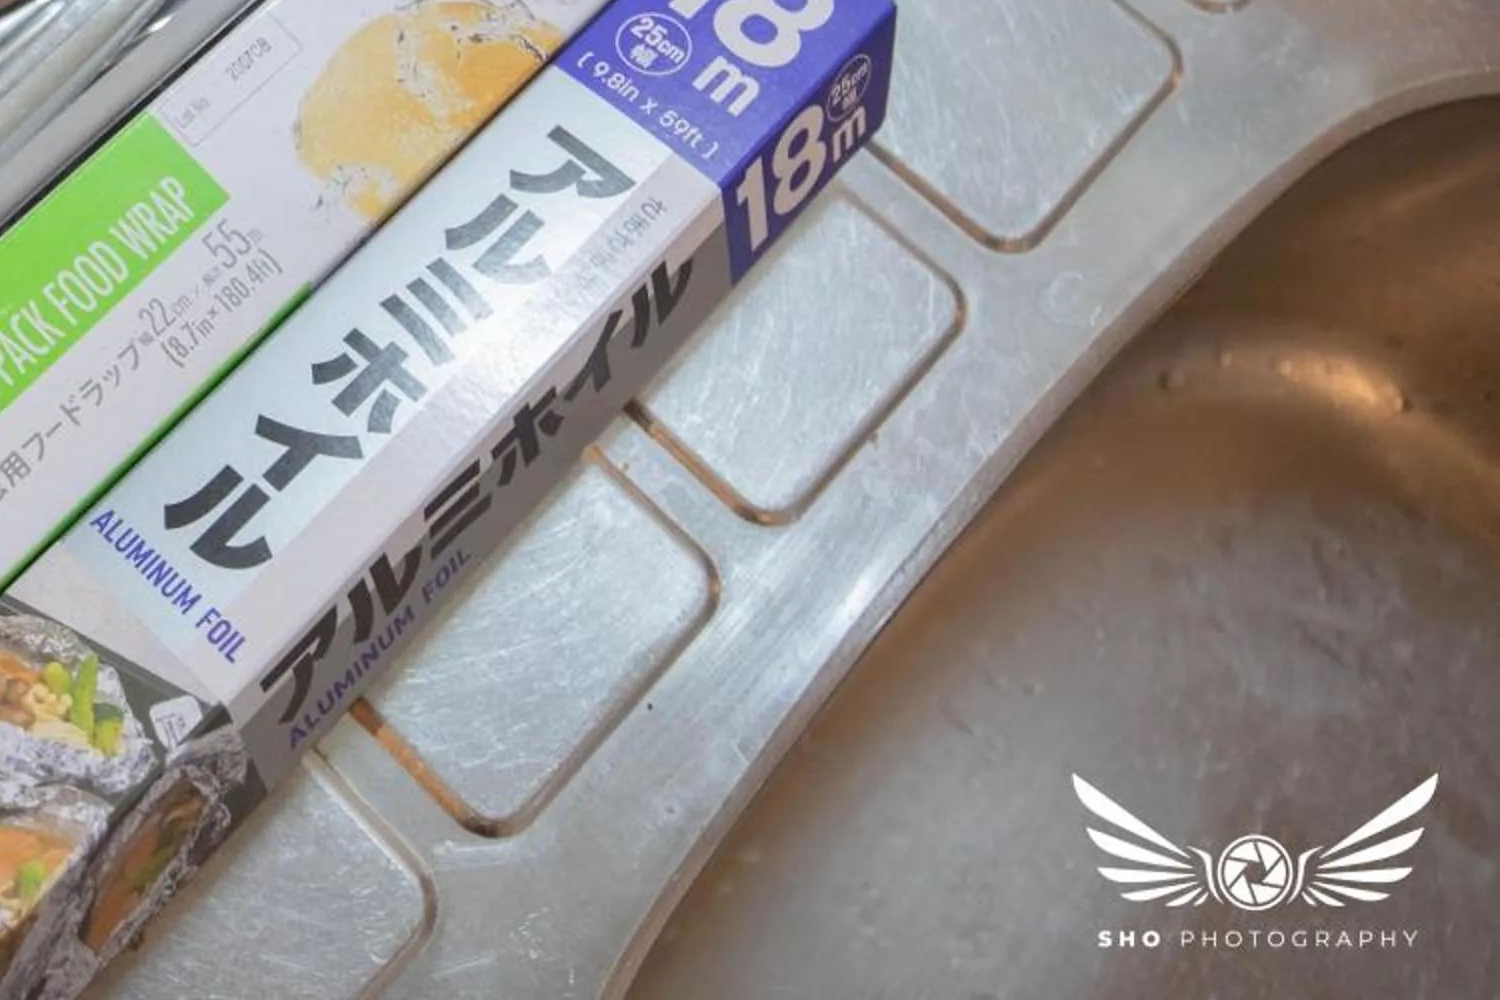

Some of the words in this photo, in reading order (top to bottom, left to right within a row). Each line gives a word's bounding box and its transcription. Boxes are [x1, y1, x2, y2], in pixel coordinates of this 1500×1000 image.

[630, 16, 686, 64] 25cm
[691, 55, 761, 117] m
[42, 240, 128, 326] FOOD
[108, 176, 195, 260] WRAP
[163, 125, 636, 570] アルミホイル
[260, 255, 694, 725] アルミホイル
[89, 508, 202, 616] ALUMINUM
[195, 606, 246, 664] FOIL
[289, 604, 416, 749] ALUMINUM
[421, 548, 472, 605] FOIL
